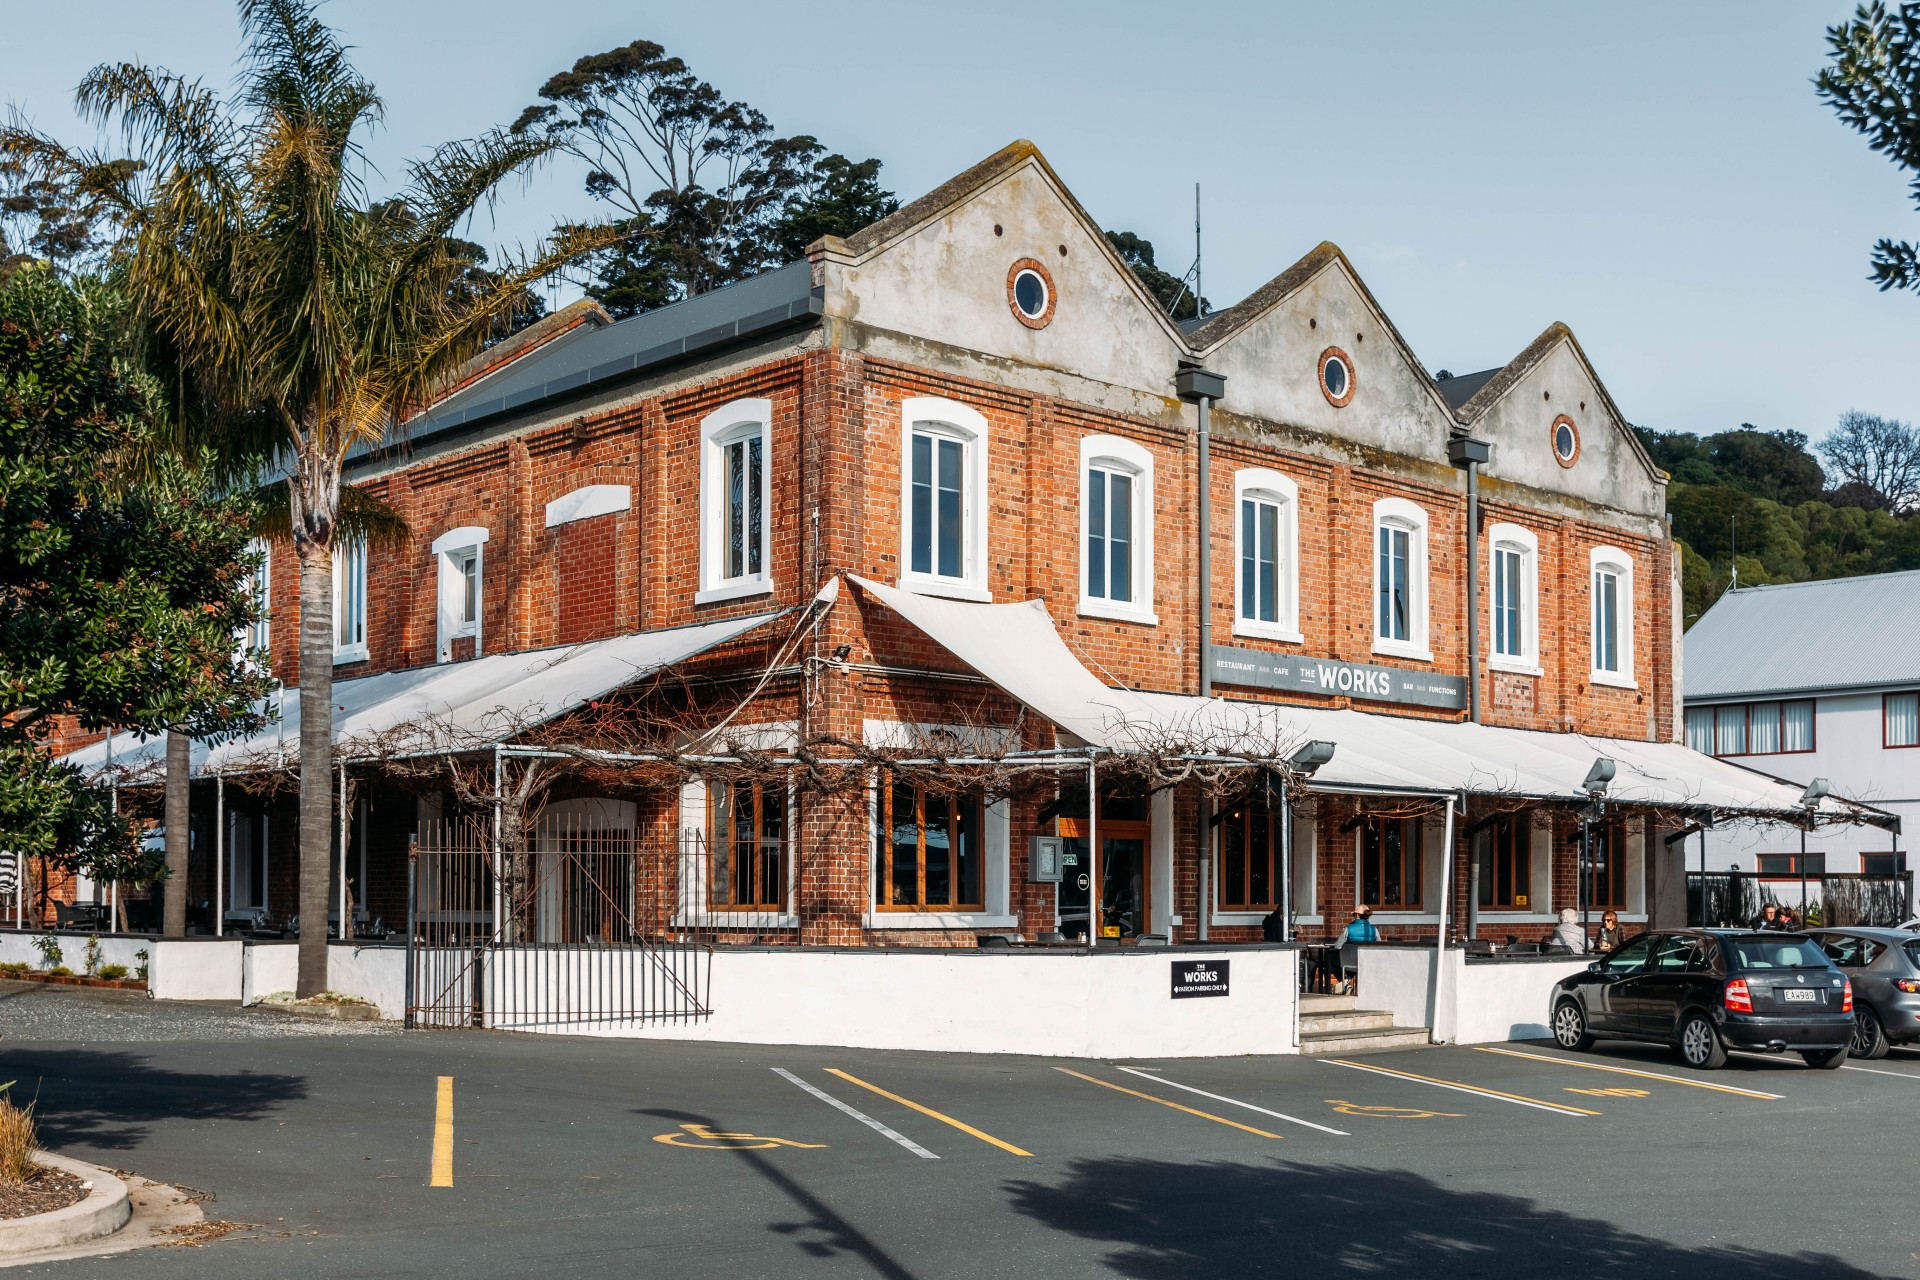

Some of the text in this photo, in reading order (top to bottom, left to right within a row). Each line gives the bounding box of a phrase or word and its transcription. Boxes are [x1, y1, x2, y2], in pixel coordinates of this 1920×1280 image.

[1216, 659, 1457, 696] RESTAURANT CAFE THE WORKS BAR FUNCTIONS
[1184, 971, 1218, 983] WORKS
[1785, 991, 1814, 1000] EAW989
